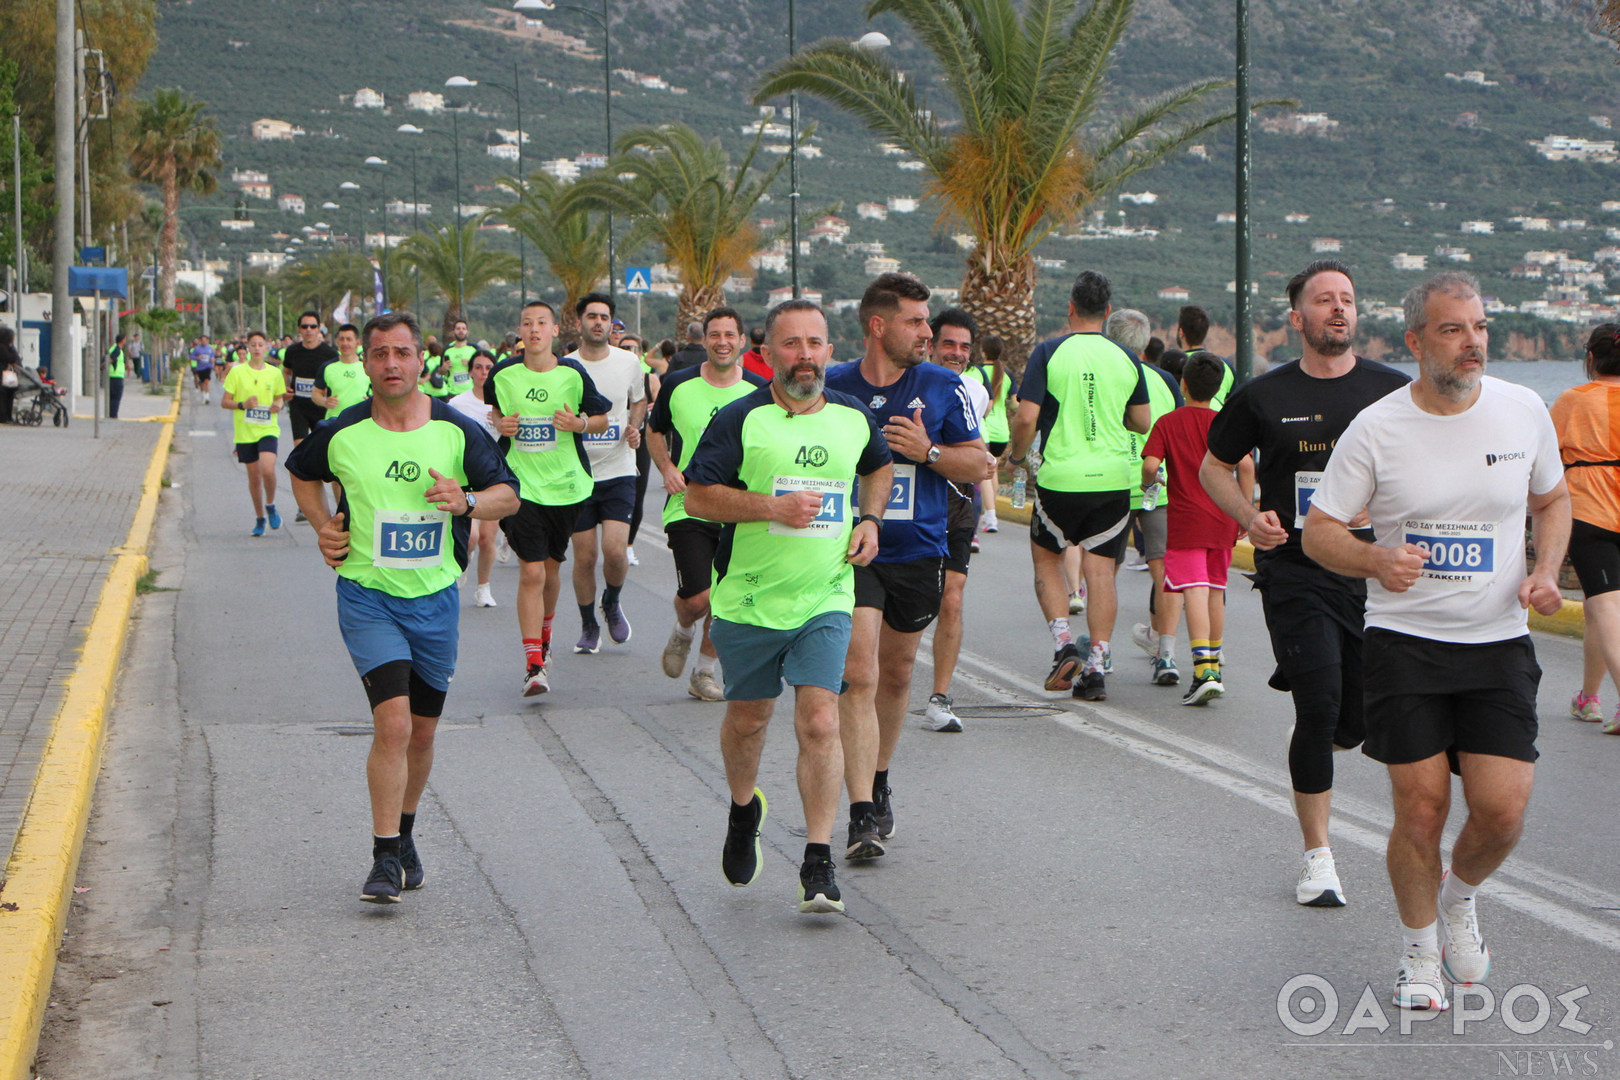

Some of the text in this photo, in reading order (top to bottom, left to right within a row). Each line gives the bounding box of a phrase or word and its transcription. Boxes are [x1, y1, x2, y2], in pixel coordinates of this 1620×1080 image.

[1082, 372, 1095, 381] 23
[518, 426, 550, 440] 2383
[1298, 440, 1327, 452] Run
[1498, 451, 1526, 462] PEOPLE
[1420, 522, 1434, 530] ΣΔΥ
[1435, 523, 1479, 532] ΜΕΣΣΗΝΙΑΣ
[387, 529, 436, 552] 1361
[1428, 573, 1473, 581] ZAKCRET
